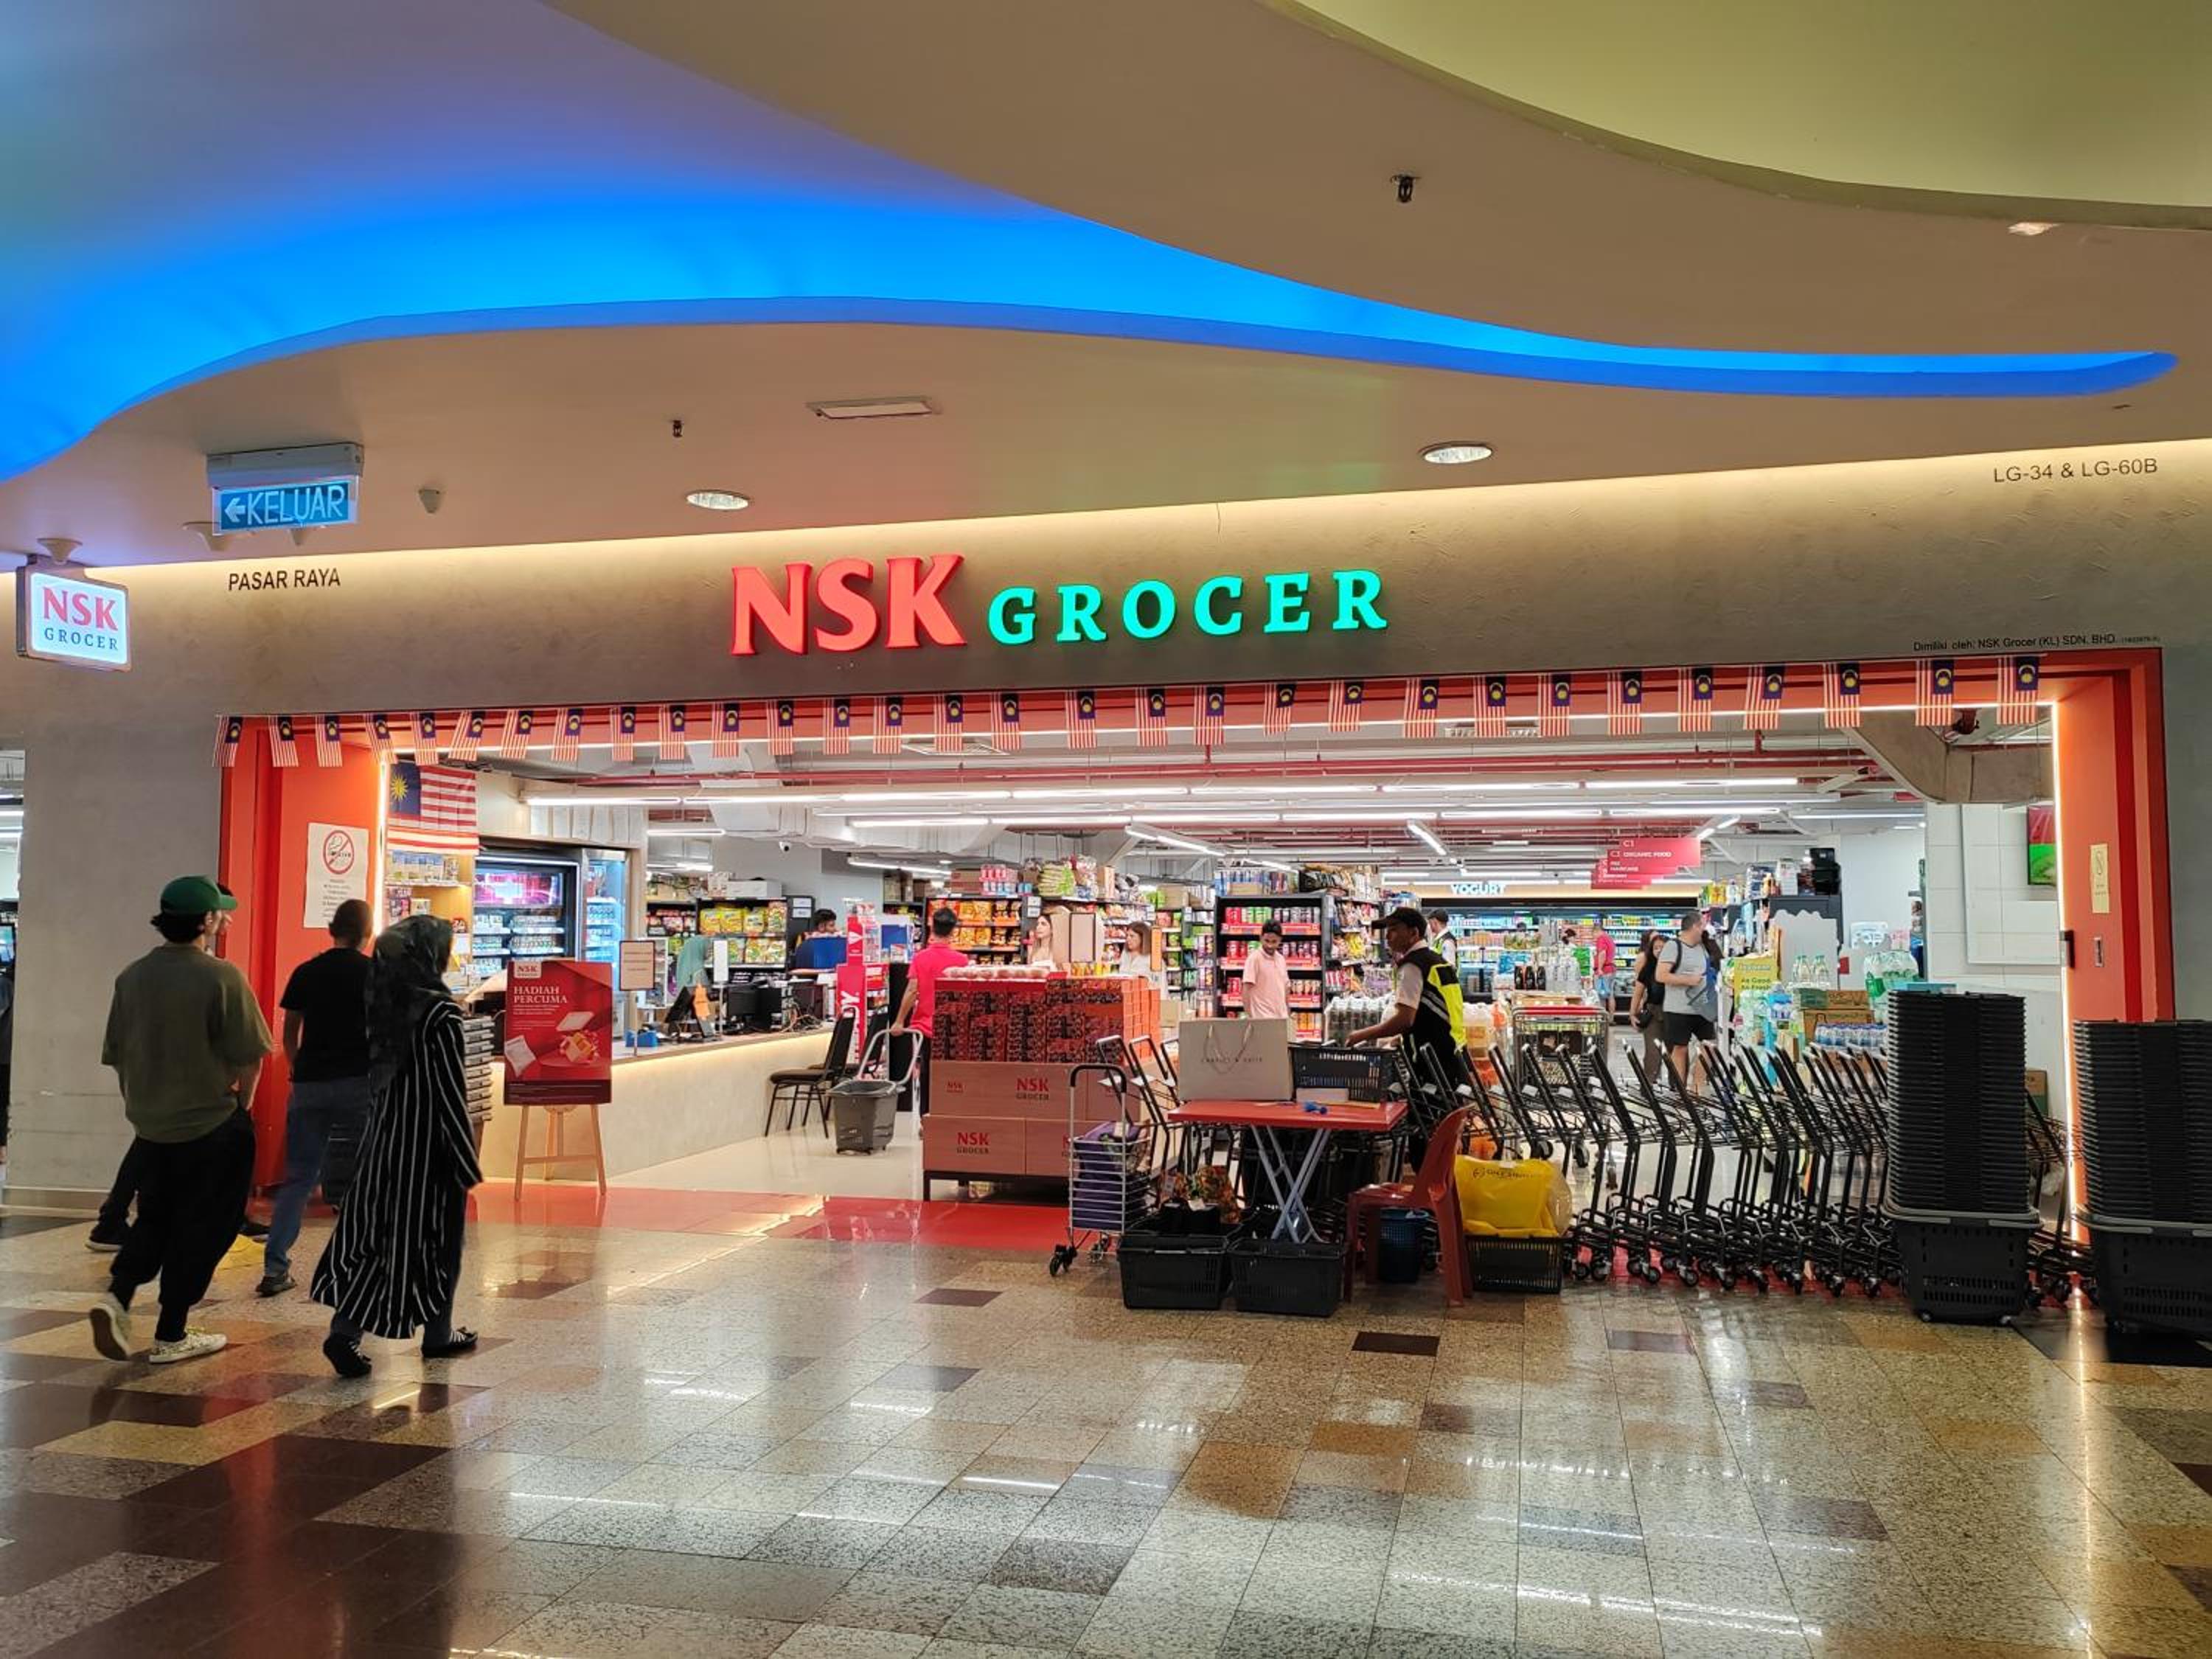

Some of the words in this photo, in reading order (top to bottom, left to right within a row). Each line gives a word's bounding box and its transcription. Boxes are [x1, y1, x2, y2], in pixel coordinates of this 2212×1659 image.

[1994, 464, 2053, 483] LG-34
[2061, 462, 2074, 479] &
[2081, 458, 2158, 477] LG-60B
[247, 484, 345, 525] KELUAR
[229, 570, 288, 591] PASAR
[294, 567, 341, 588] RAYA
[43, 586, 119, 631] NSK
[731, 554, 967, 655] NSK
[987, 569, 1388, 645] GROCER
[44, 627, 118, 650] GROCER
[1978, 639, 2000, 649] NSK
[2003, 636, 2037, 647] Grocer
[2039, 636, 2059, 648] (KL)
[1450, 883, 1506, 895] YOGURT
[513, 986, 560, 995] HADIAH
[513, 995, 568, 1004] PERCUMA
[1016, 1078, 1049, 1092] NSK
[1015, 1092, 1049, 1101] GROCER
[957, 1132, 990, 1145] NSK
[956, 1147, 989, 1155] GROCER
